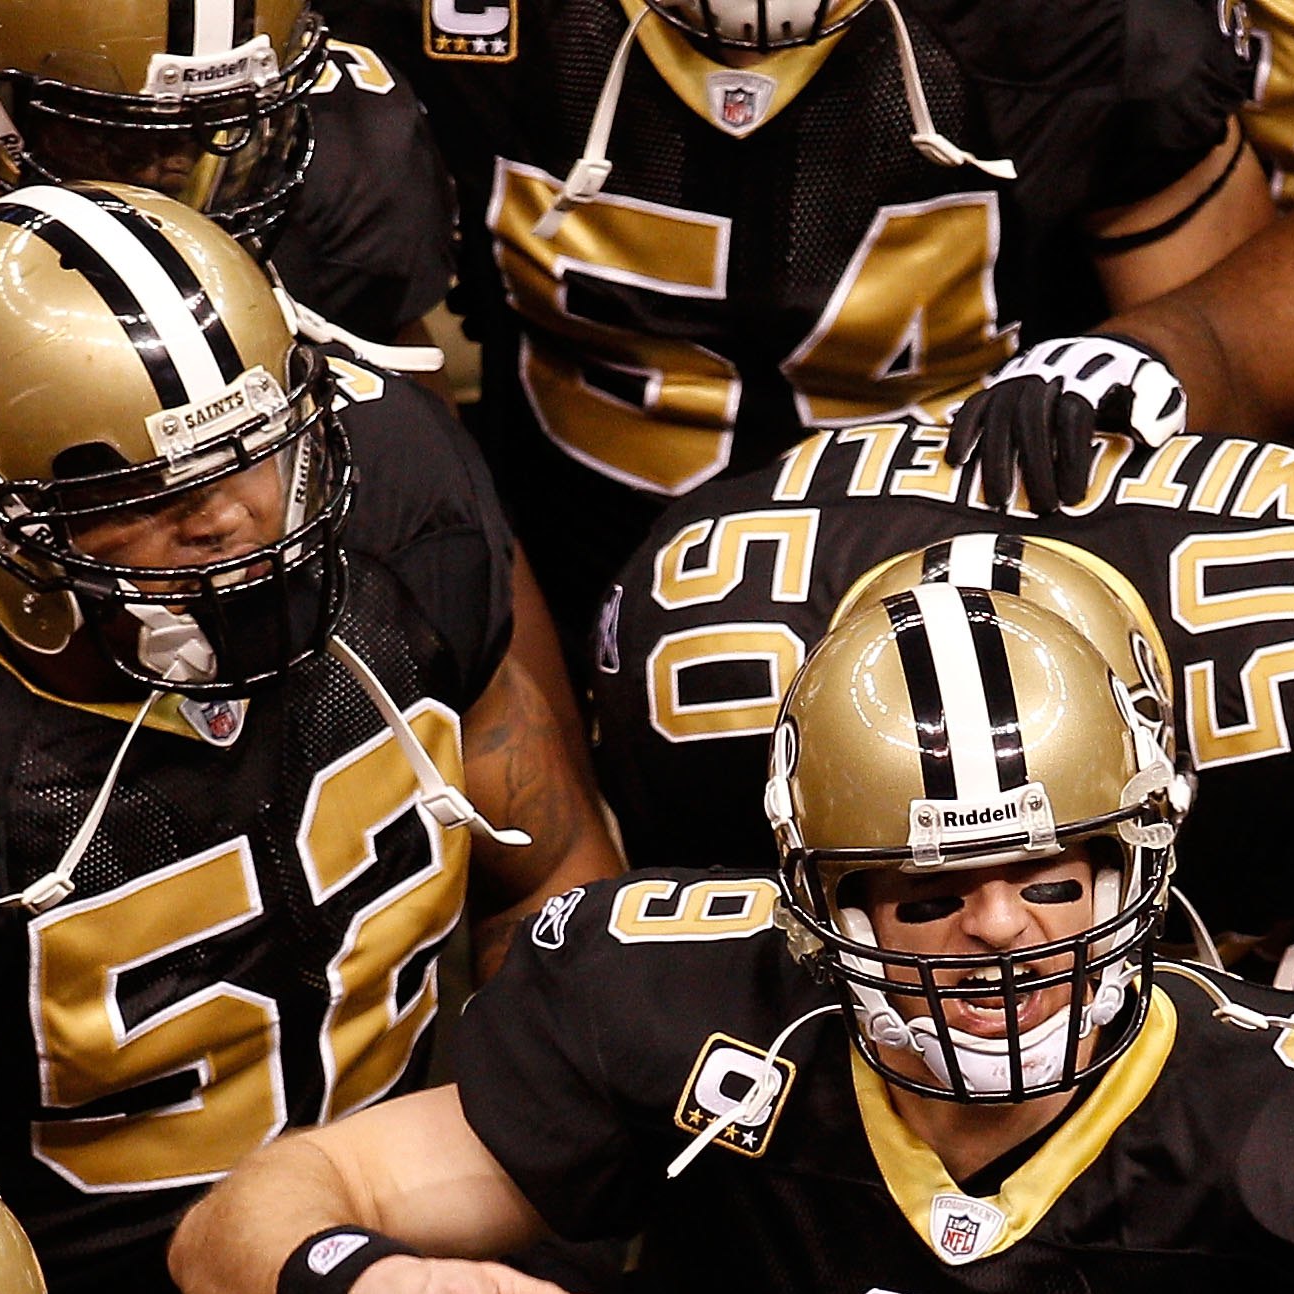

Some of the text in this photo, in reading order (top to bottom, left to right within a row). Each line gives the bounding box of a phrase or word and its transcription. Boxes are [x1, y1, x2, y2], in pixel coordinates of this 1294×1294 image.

[486, 155, 1021, 497] 54
[184, 390, 244, 428] SAINTS
[646, 508, 819, 743] 50
[942, 802, 1018, 828] Riddell
[608, 878, 784, 945] 9
[27, 697, 469, 1195] 52
[943, 1229, 972, 1252] NFL
